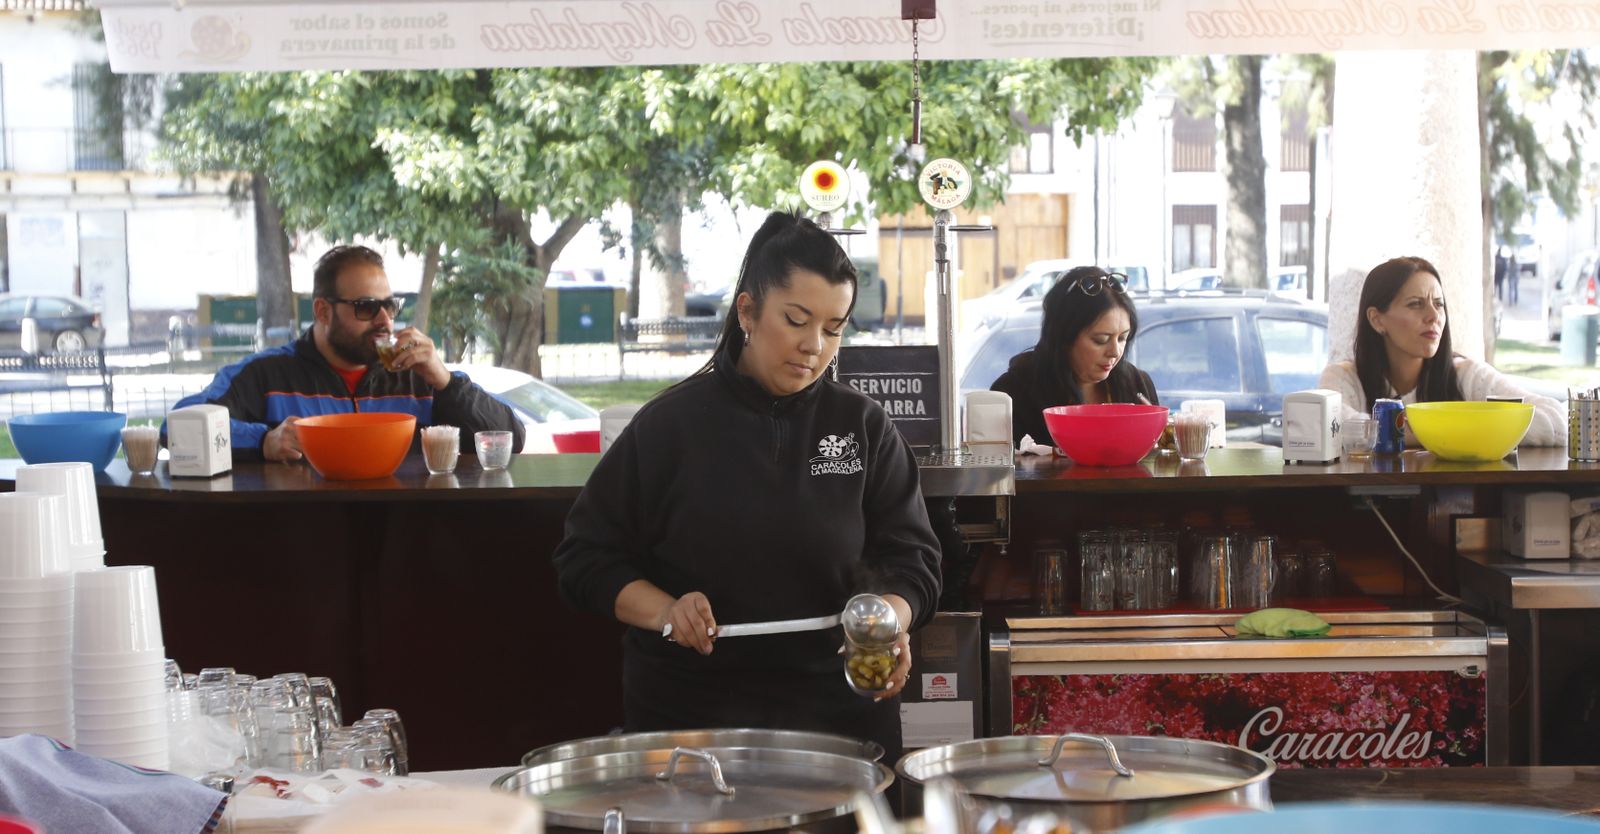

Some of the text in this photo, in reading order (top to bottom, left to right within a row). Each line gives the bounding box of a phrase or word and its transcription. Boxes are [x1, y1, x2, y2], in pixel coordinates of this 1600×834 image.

[926, 163, 961, 177] VICTORIA
[849, 378, 922, 394] SERVICIO
[884, 400, 926, 415] ARRA
[811, 458, 862, 471] CARACOLES
[821, 465, 864, 475] MAGDALENA
[1238, 706, 1433, 760] Caracoles
